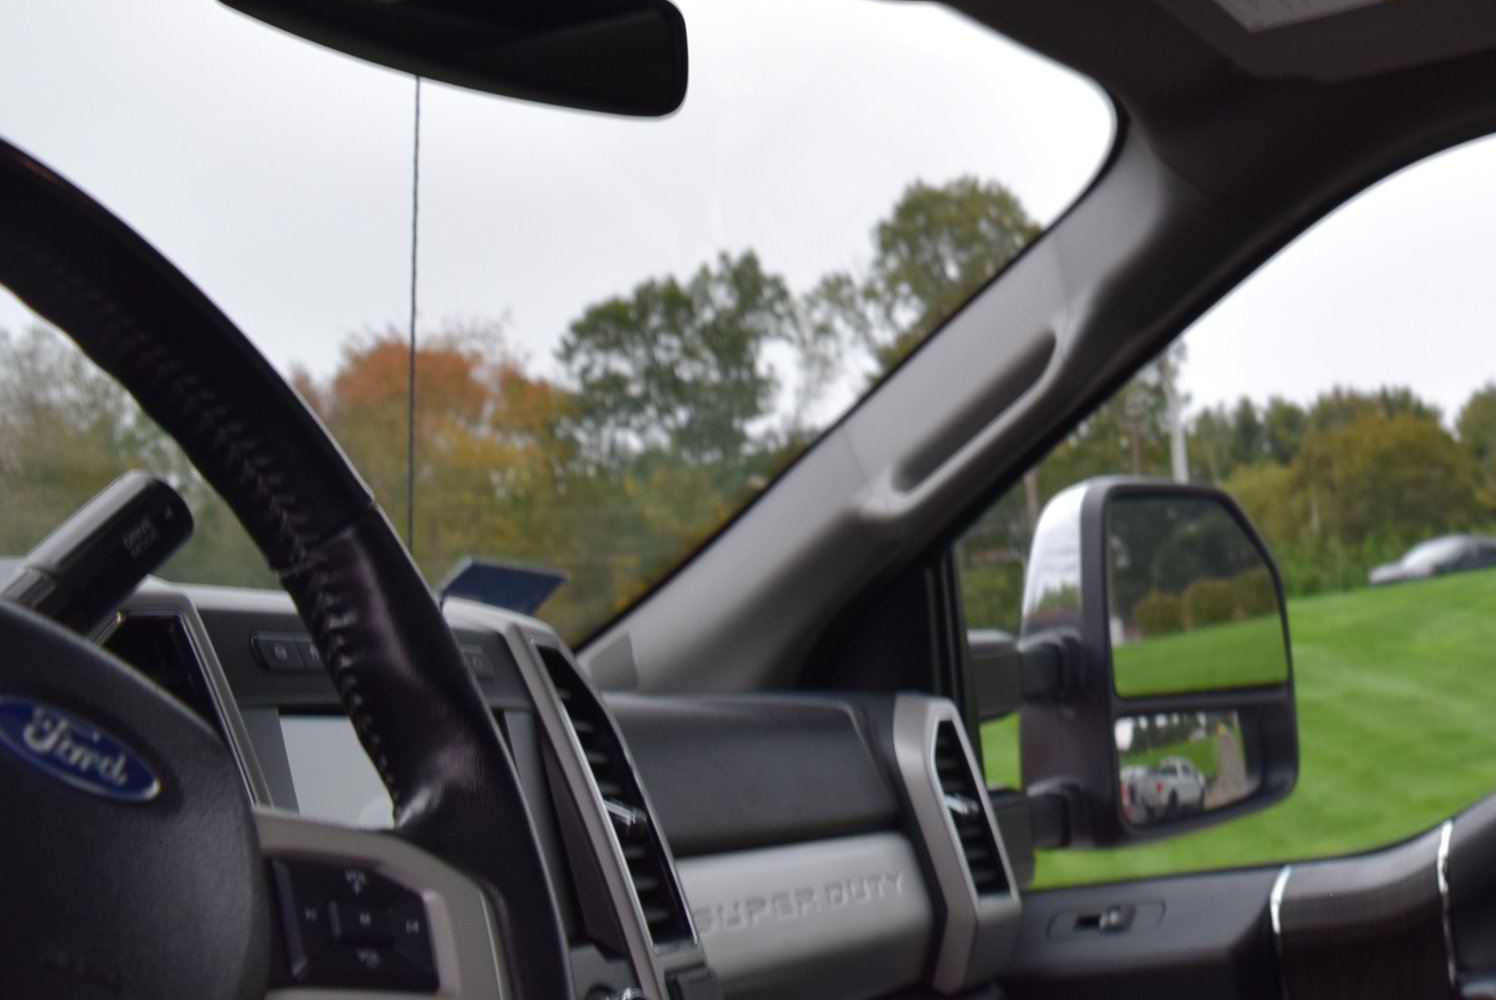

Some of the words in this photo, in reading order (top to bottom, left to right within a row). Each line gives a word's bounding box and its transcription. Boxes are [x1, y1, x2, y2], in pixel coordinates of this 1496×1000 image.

[23, 707, 129, 786] Ford
[694, 885, 823, 936] SUPER
[824, 872, 903, 909] DUTY
